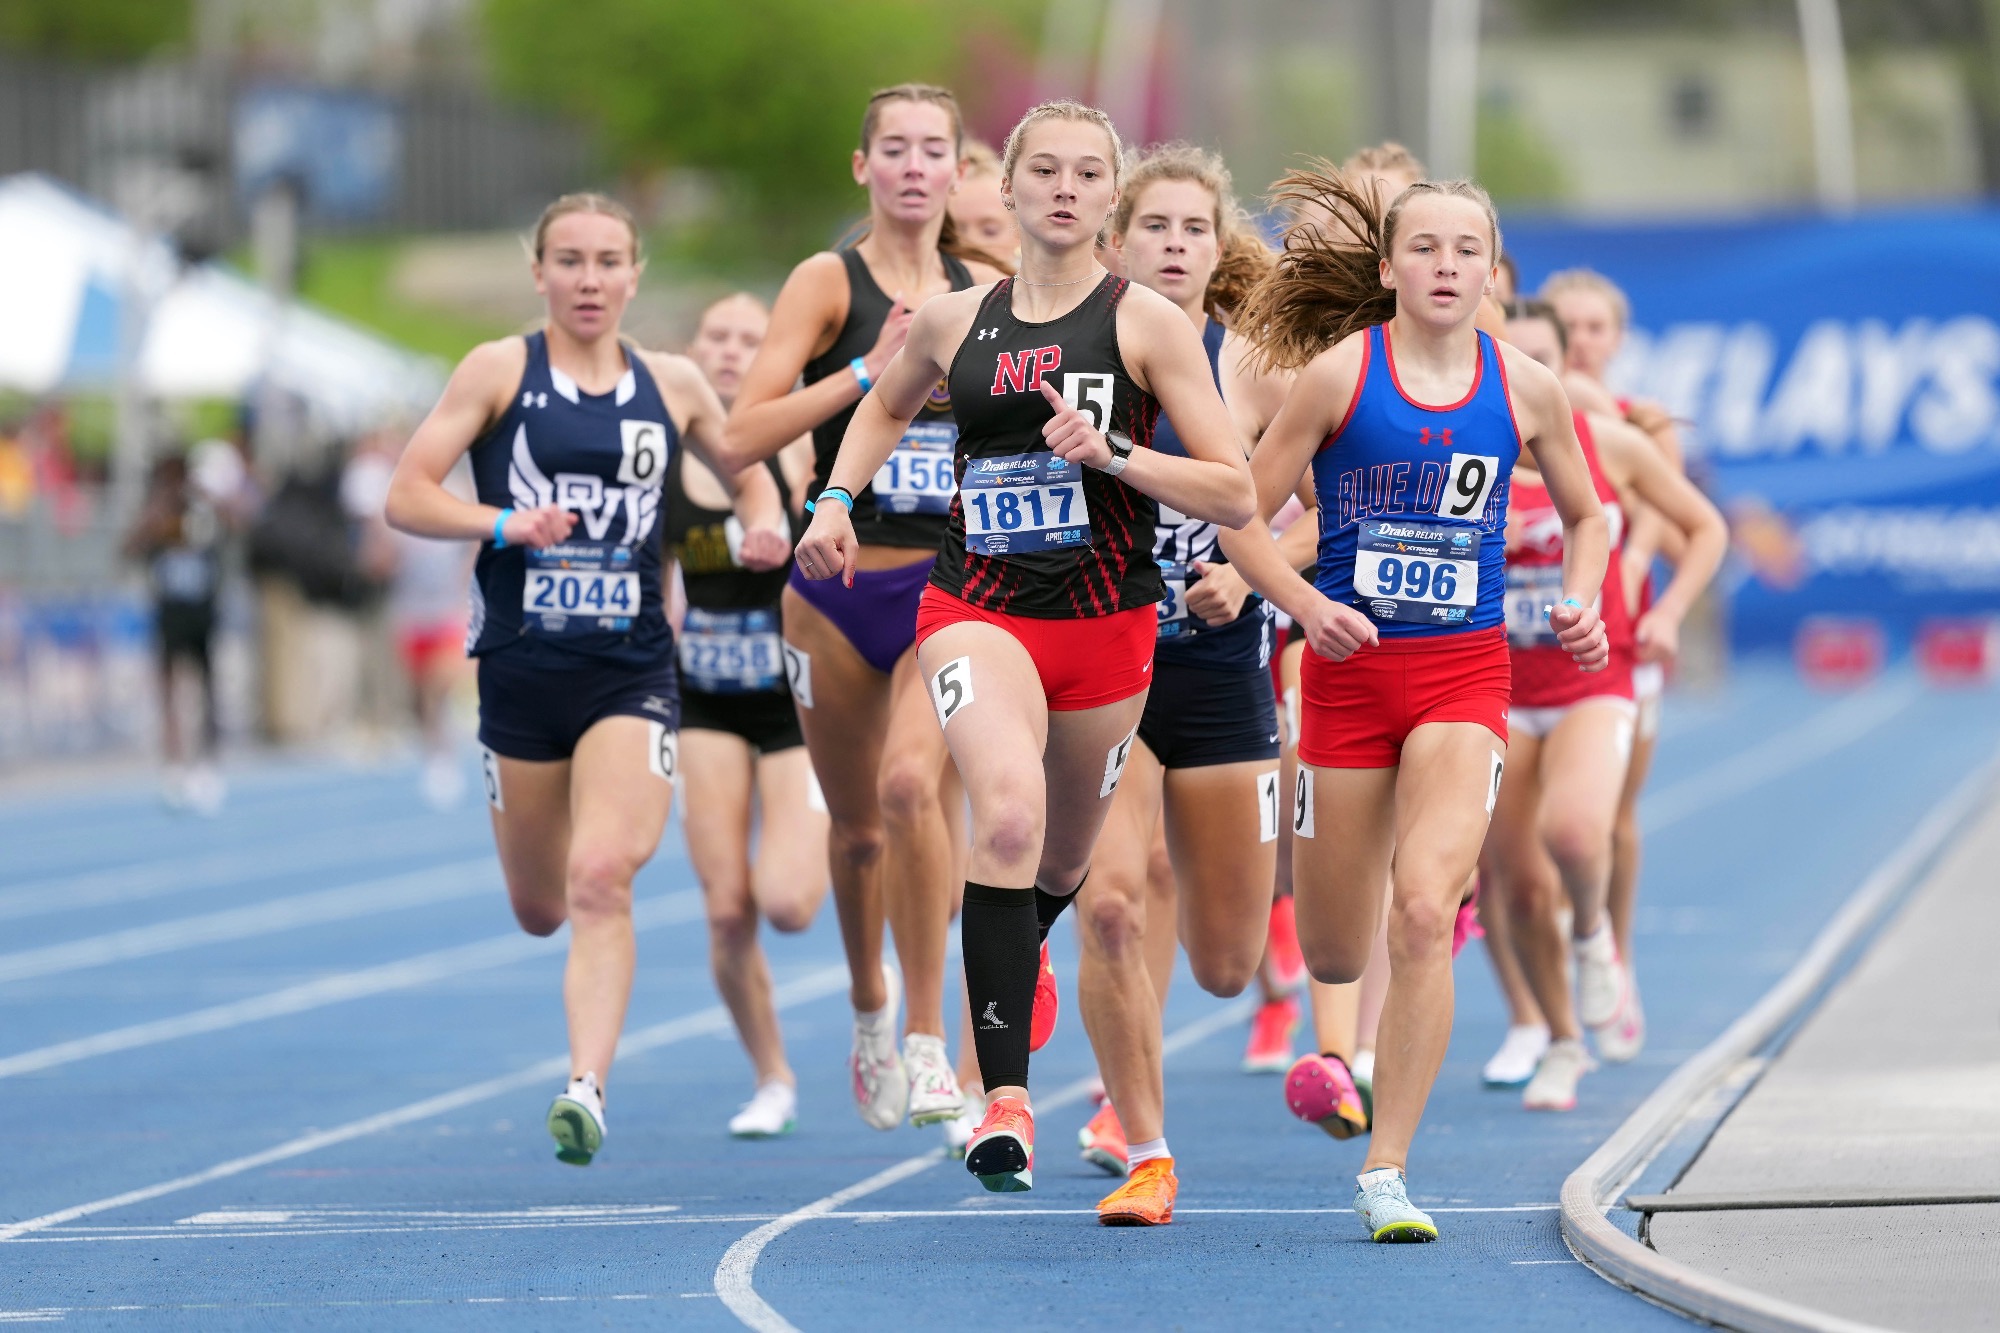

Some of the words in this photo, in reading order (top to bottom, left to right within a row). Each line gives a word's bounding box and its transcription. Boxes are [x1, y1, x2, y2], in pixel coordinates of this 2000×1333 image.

[991, 344, 1062, 396] NP
[1076, 377, 1104, 430] 5
[634, 428, 655, 480] 6
[980, 459, 1009, 472] Drake
[1009, 459, 1037, 469] RELAYS
[972, 488, 1074, 531] 1817
[1339, 462, 1411, 529] BLUE
[1450, 458, 1487, 516] 9
[1045, 532, 1062, 542] APRIL
[1378, 523, 1415, 538] Drake
[1414, 531, 1444, 541] RELAYS
[534, 575, 630, 610] 2044
[1376, 557, 1458, 601] 996
[939, 662, 962, 717] 5
[658, 730, 674, 777] 6
[1267, 776, 1276, 835] 1
[1295, 769, 1306, 831] 9
